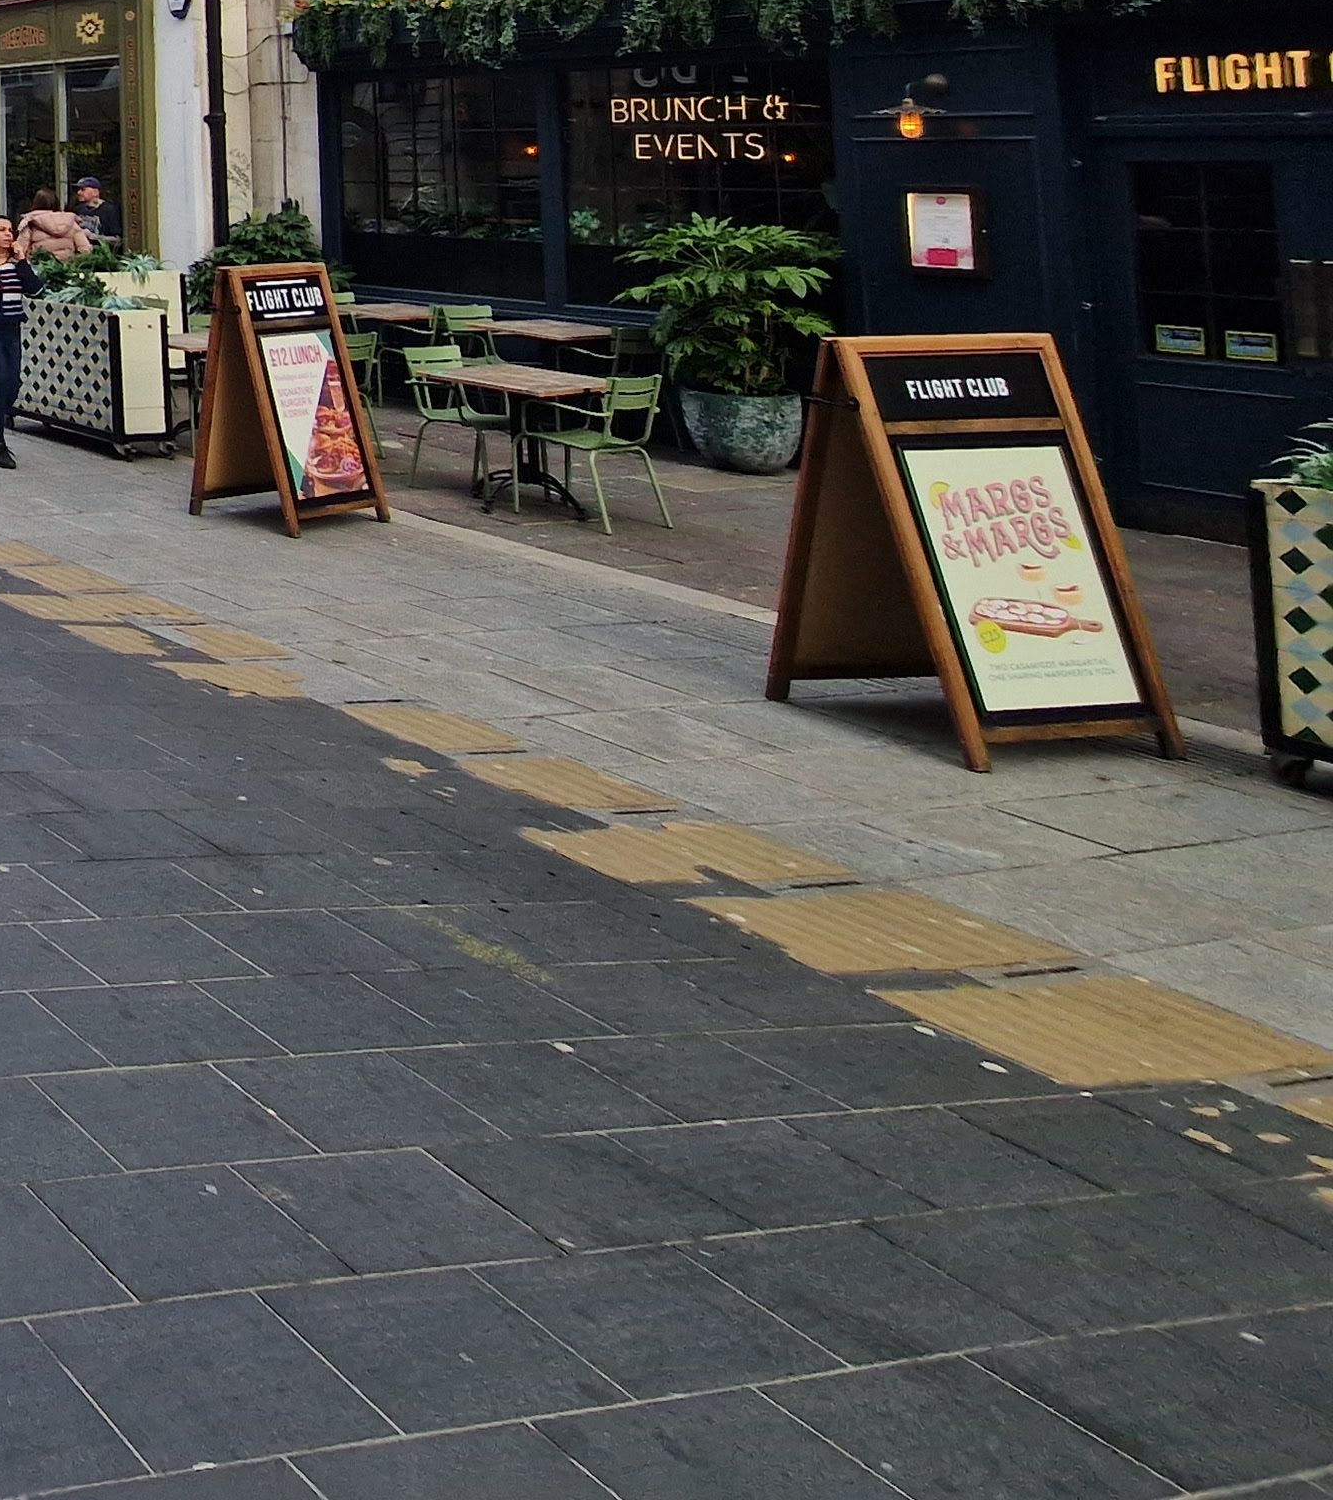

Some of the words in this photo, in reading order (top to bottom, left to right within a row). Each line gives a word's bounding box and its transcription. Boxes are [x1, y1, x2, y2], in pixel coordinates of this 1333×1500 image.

[0, 25, 46, 51] PIERCING
[1154, 50, 1311, 93] FLIGHT
[610, 94, 747, 123] BRUNCH
[763, 94, 790, 120] &
[634, 132, 766, 160] EVENTS
[246, 288, 290, 312] FLIGHT
[291, 286, 324, 307] CLUB
[269, 348, 290, 368] £12
[290, 344, 323, 365] LUNCH
[905, 379, 964, 400] FLIGHT
[966, 377, 1011, 398] CLUB
[938, 475, 1053, 531] MARGS
